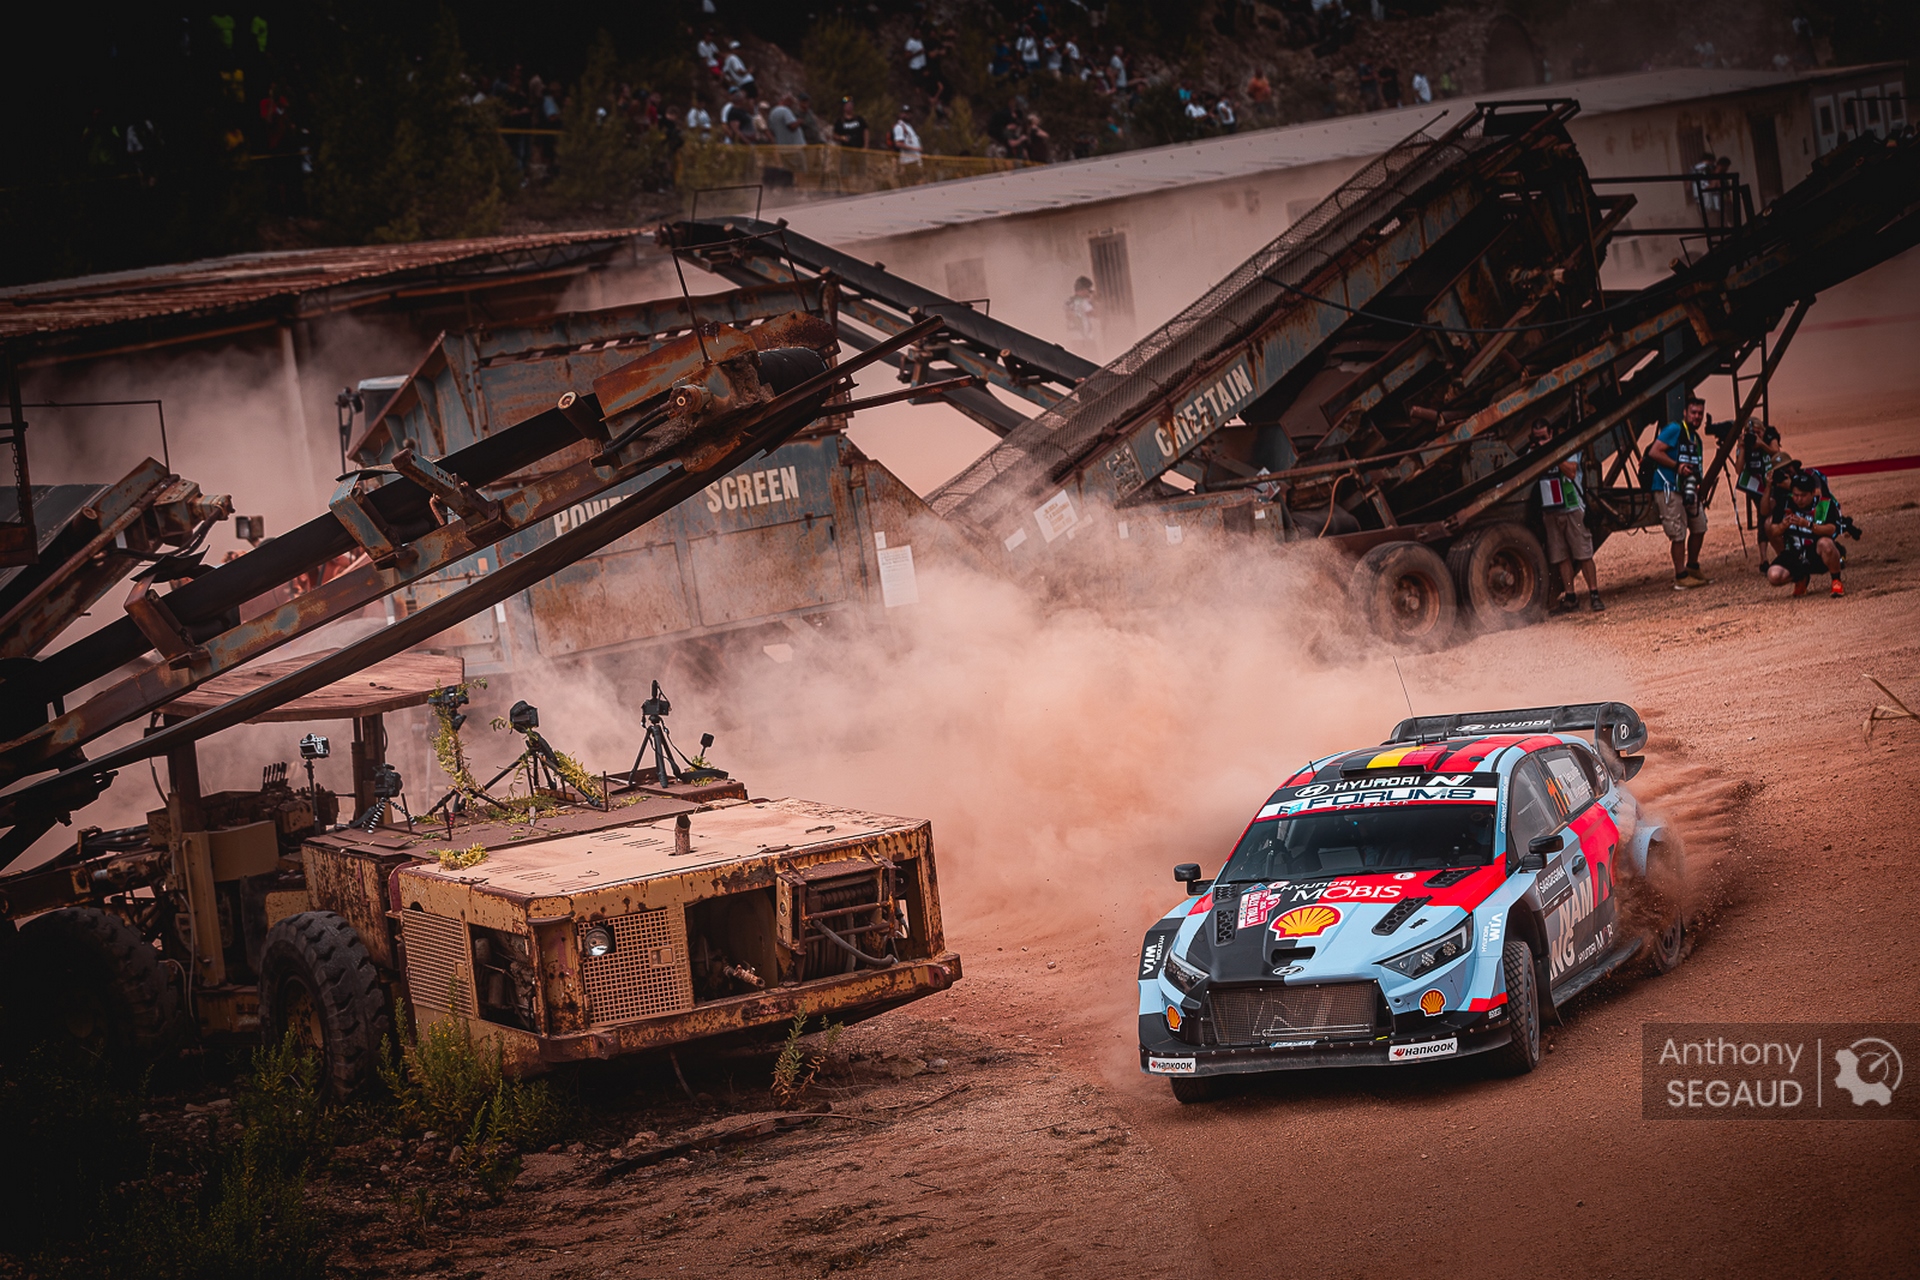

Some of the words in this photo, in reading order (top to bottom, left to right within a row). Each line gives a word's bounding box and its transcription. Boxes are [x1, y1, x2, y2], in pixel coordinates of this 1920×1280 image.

[1154, 364, 1253, 457] CHIEFTAIN
[553, 494, 634, 537] POW
[704, 466, 799, 513] SCREEN
[1489, 719, 1551, 730] HYUNDA
[1334, 776, 1420, 792] HYUNDAI
[1307, 789, 1477, 809] FORUM8
[1282, 880, 1356, 892] HYUNDAI
[1290, 886, 1402, 902] MOBIS
[1156, 935, 1166, 961] HYUNDAI
[1481, 925, 1489, 953] HYUNDAI
